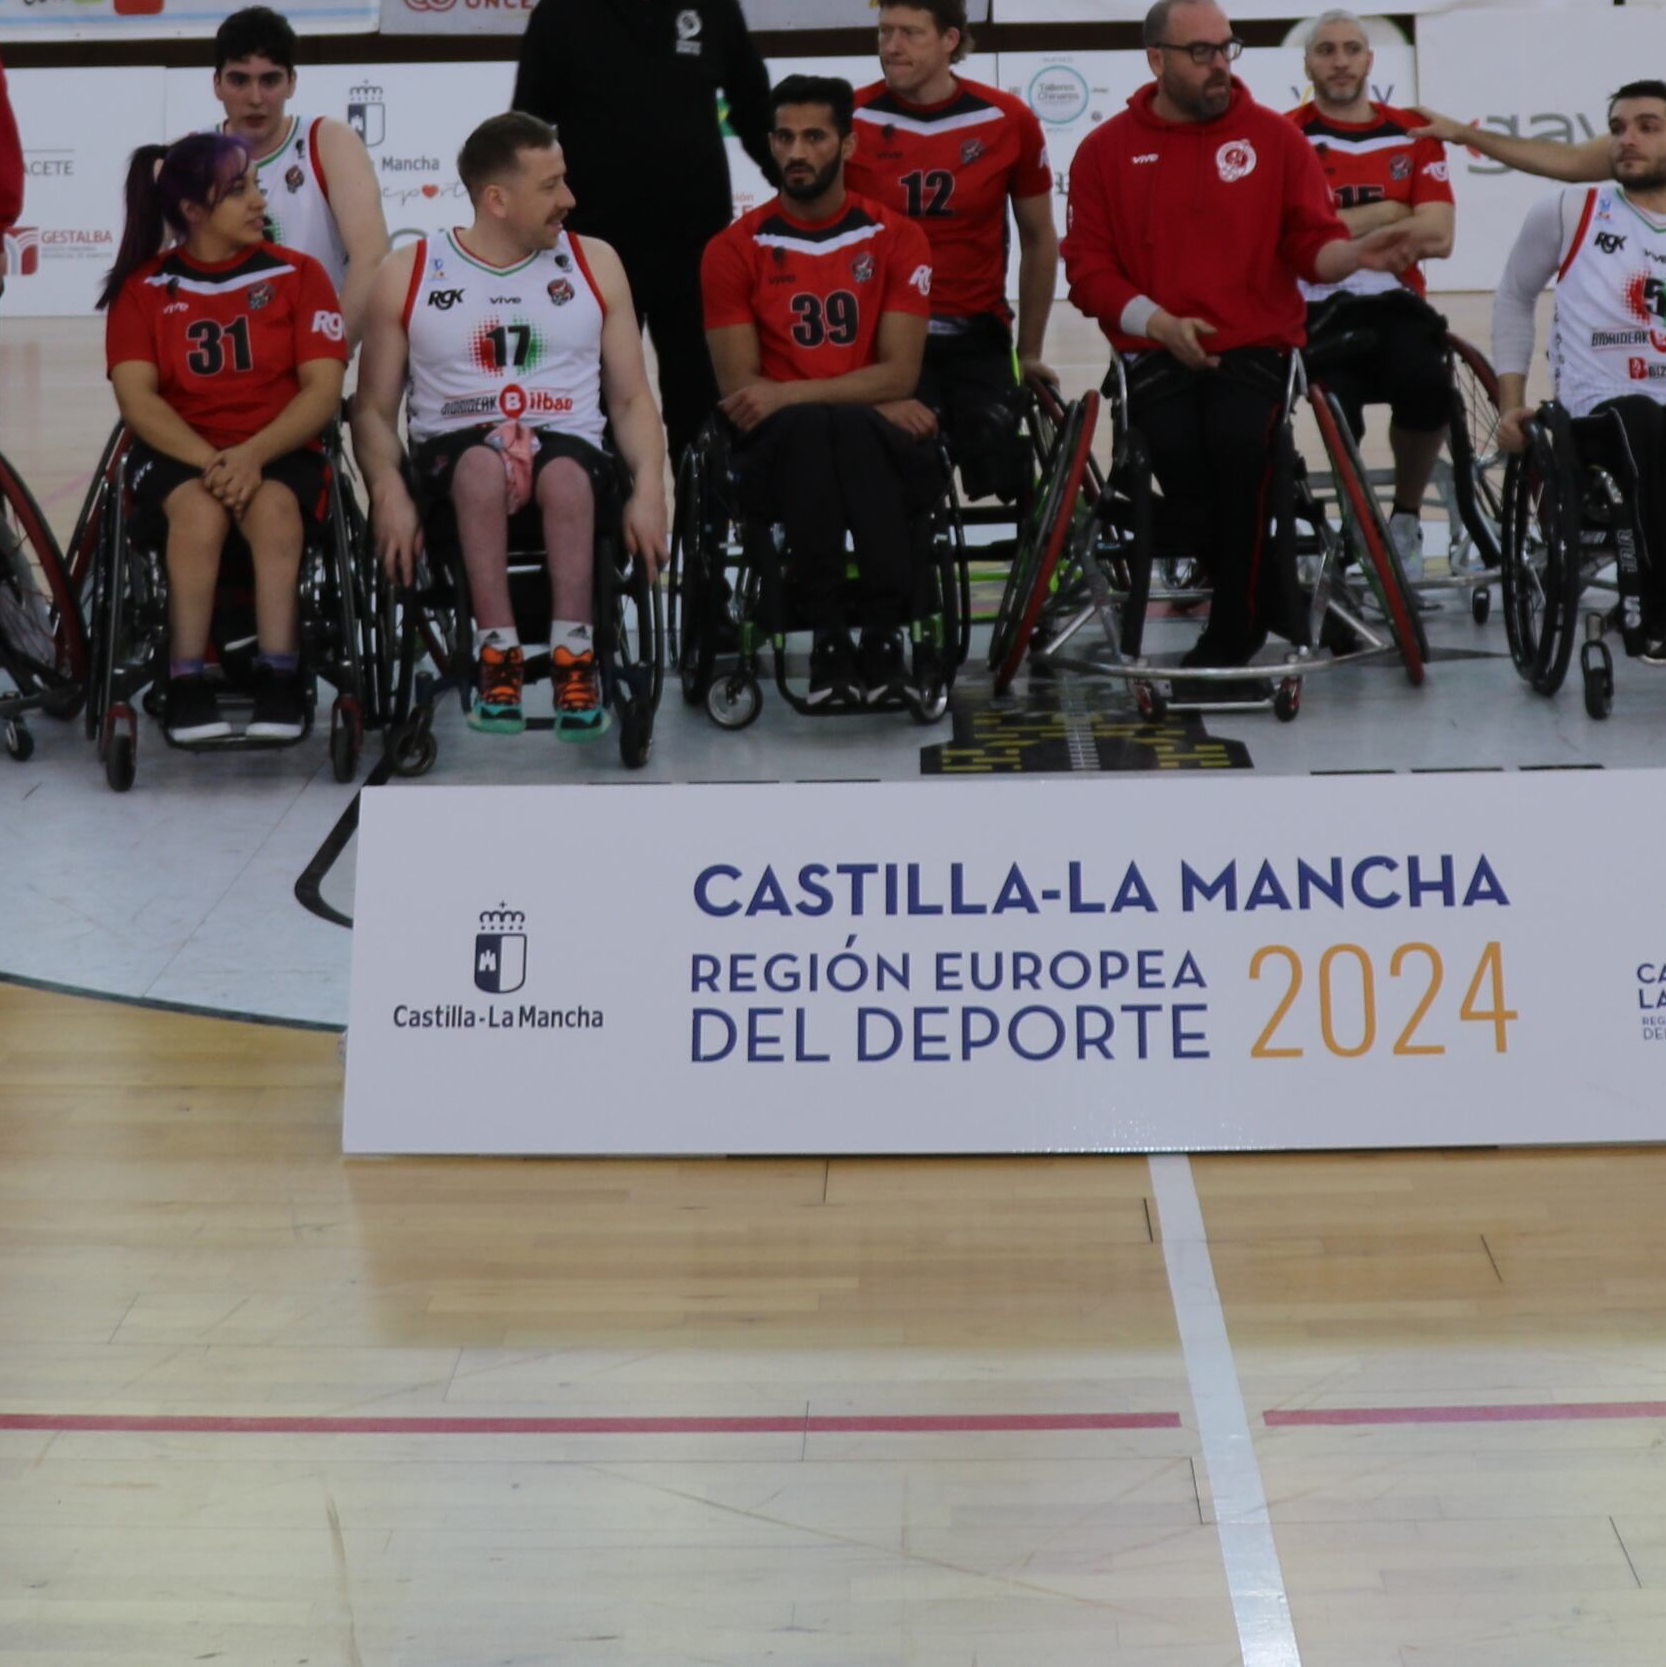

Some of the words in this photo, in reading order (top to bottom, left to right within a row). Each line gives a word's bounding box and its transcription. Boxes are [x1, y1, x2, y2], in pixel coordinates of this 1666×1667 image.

[382, 156, 440, 171] Mancha
[898, 169, 957, 217] 12
[40, 229, 113, 244] GESTALBA
[186, 313, 254, 377] 31
[485, 324, 531, 367] 17
[790, 289, 860, 349] 39
[693, 858, 1158, 917] CASTILLA-LA
[1180, 853, 1511, 914] MANCHA
[690, 934, 912, 994] REGIÓN
[935, 948, 1208, 992] EUROPEA
[518, 1004, 604, 1029] Mancha
[1247, 940, 1520, 1059] 2024
[690, 1006, 831, 1064] DEL
[856, 1002, 1211, 1063] DEPORTE
